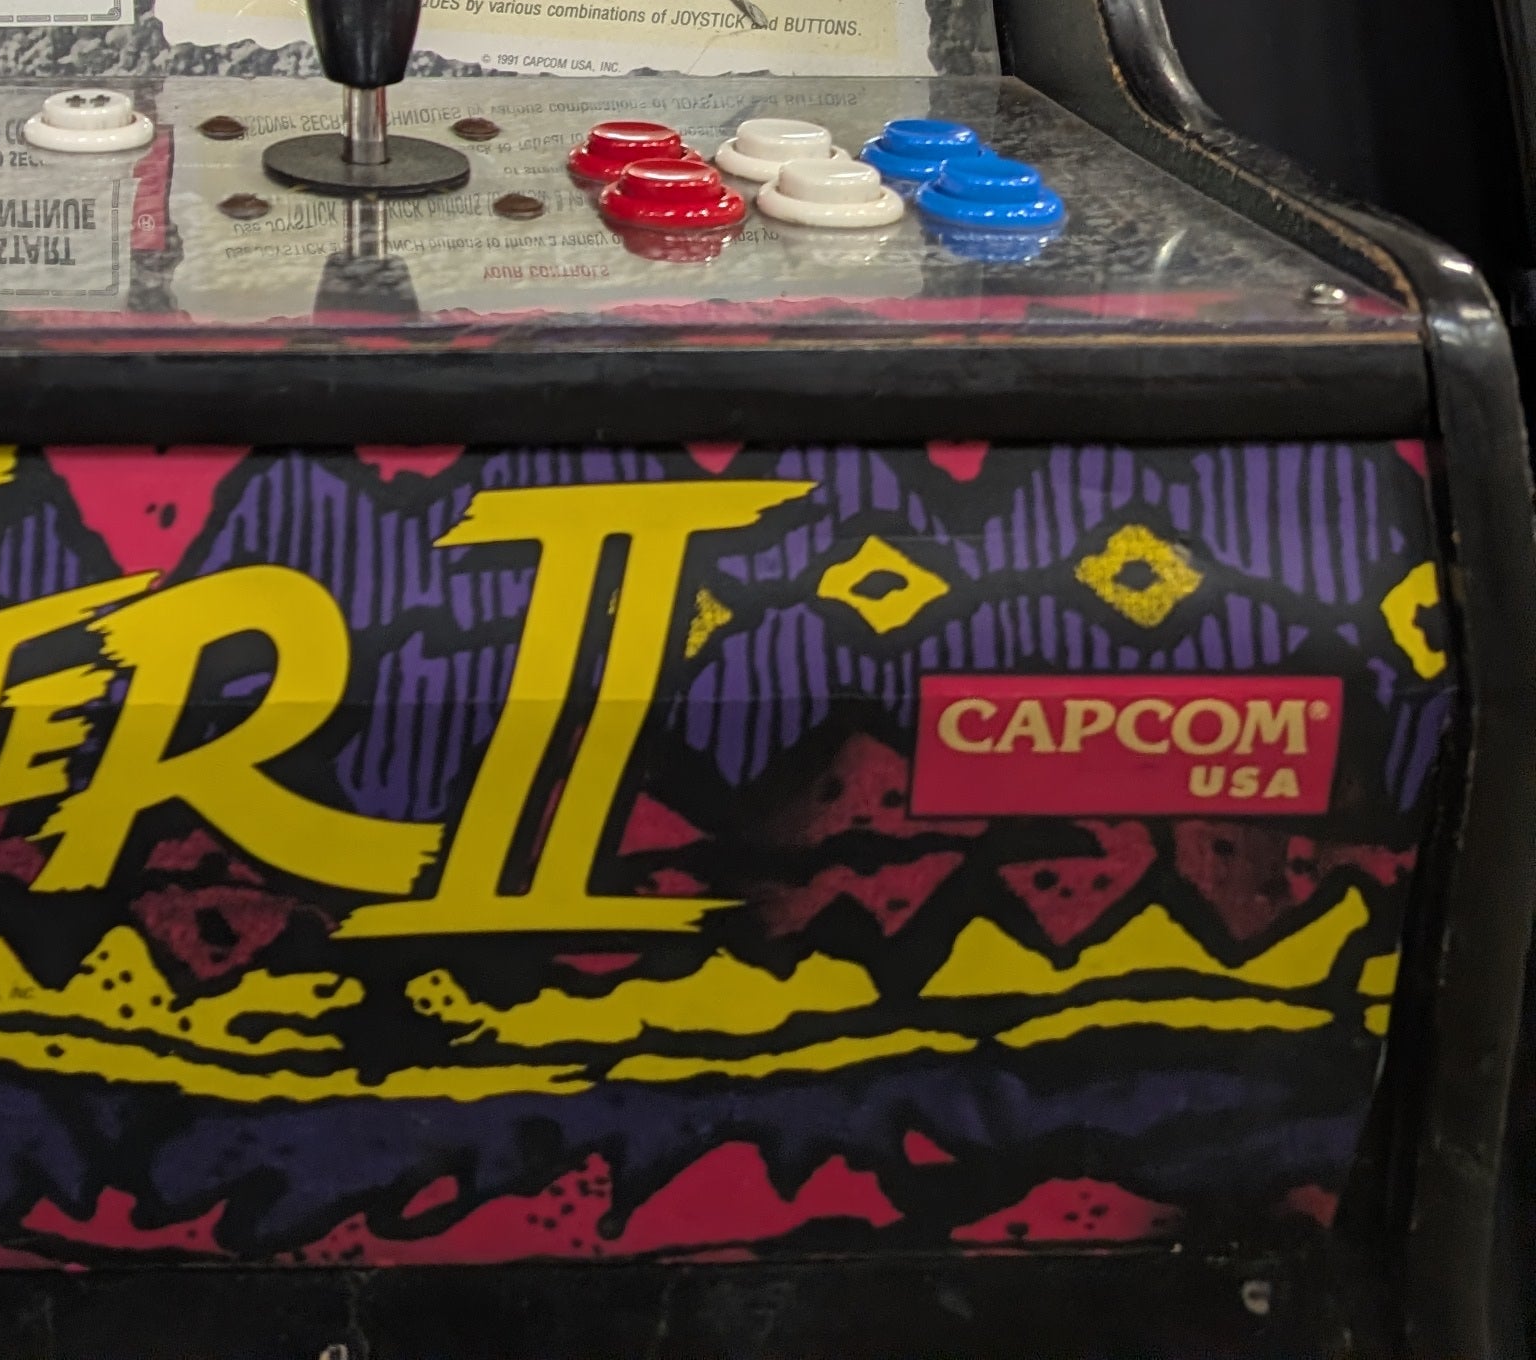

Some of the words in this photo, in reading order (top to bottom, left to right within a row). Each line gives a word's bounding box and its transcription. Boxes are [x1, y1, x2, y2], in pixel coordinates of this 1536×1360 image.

[547, 2, 646, 24] combinations
[651, 9, 667, 24] of
[671, 10, 745, 29] JOYSTICK
[784, 16, 863, 36] BUTTONS.
[497, 53, 519, 65] 1991
[523, 55, 568, 69] CAPCOM
[331, 479, 820, 940] II
[1188, 765, 1300, 799] USA
